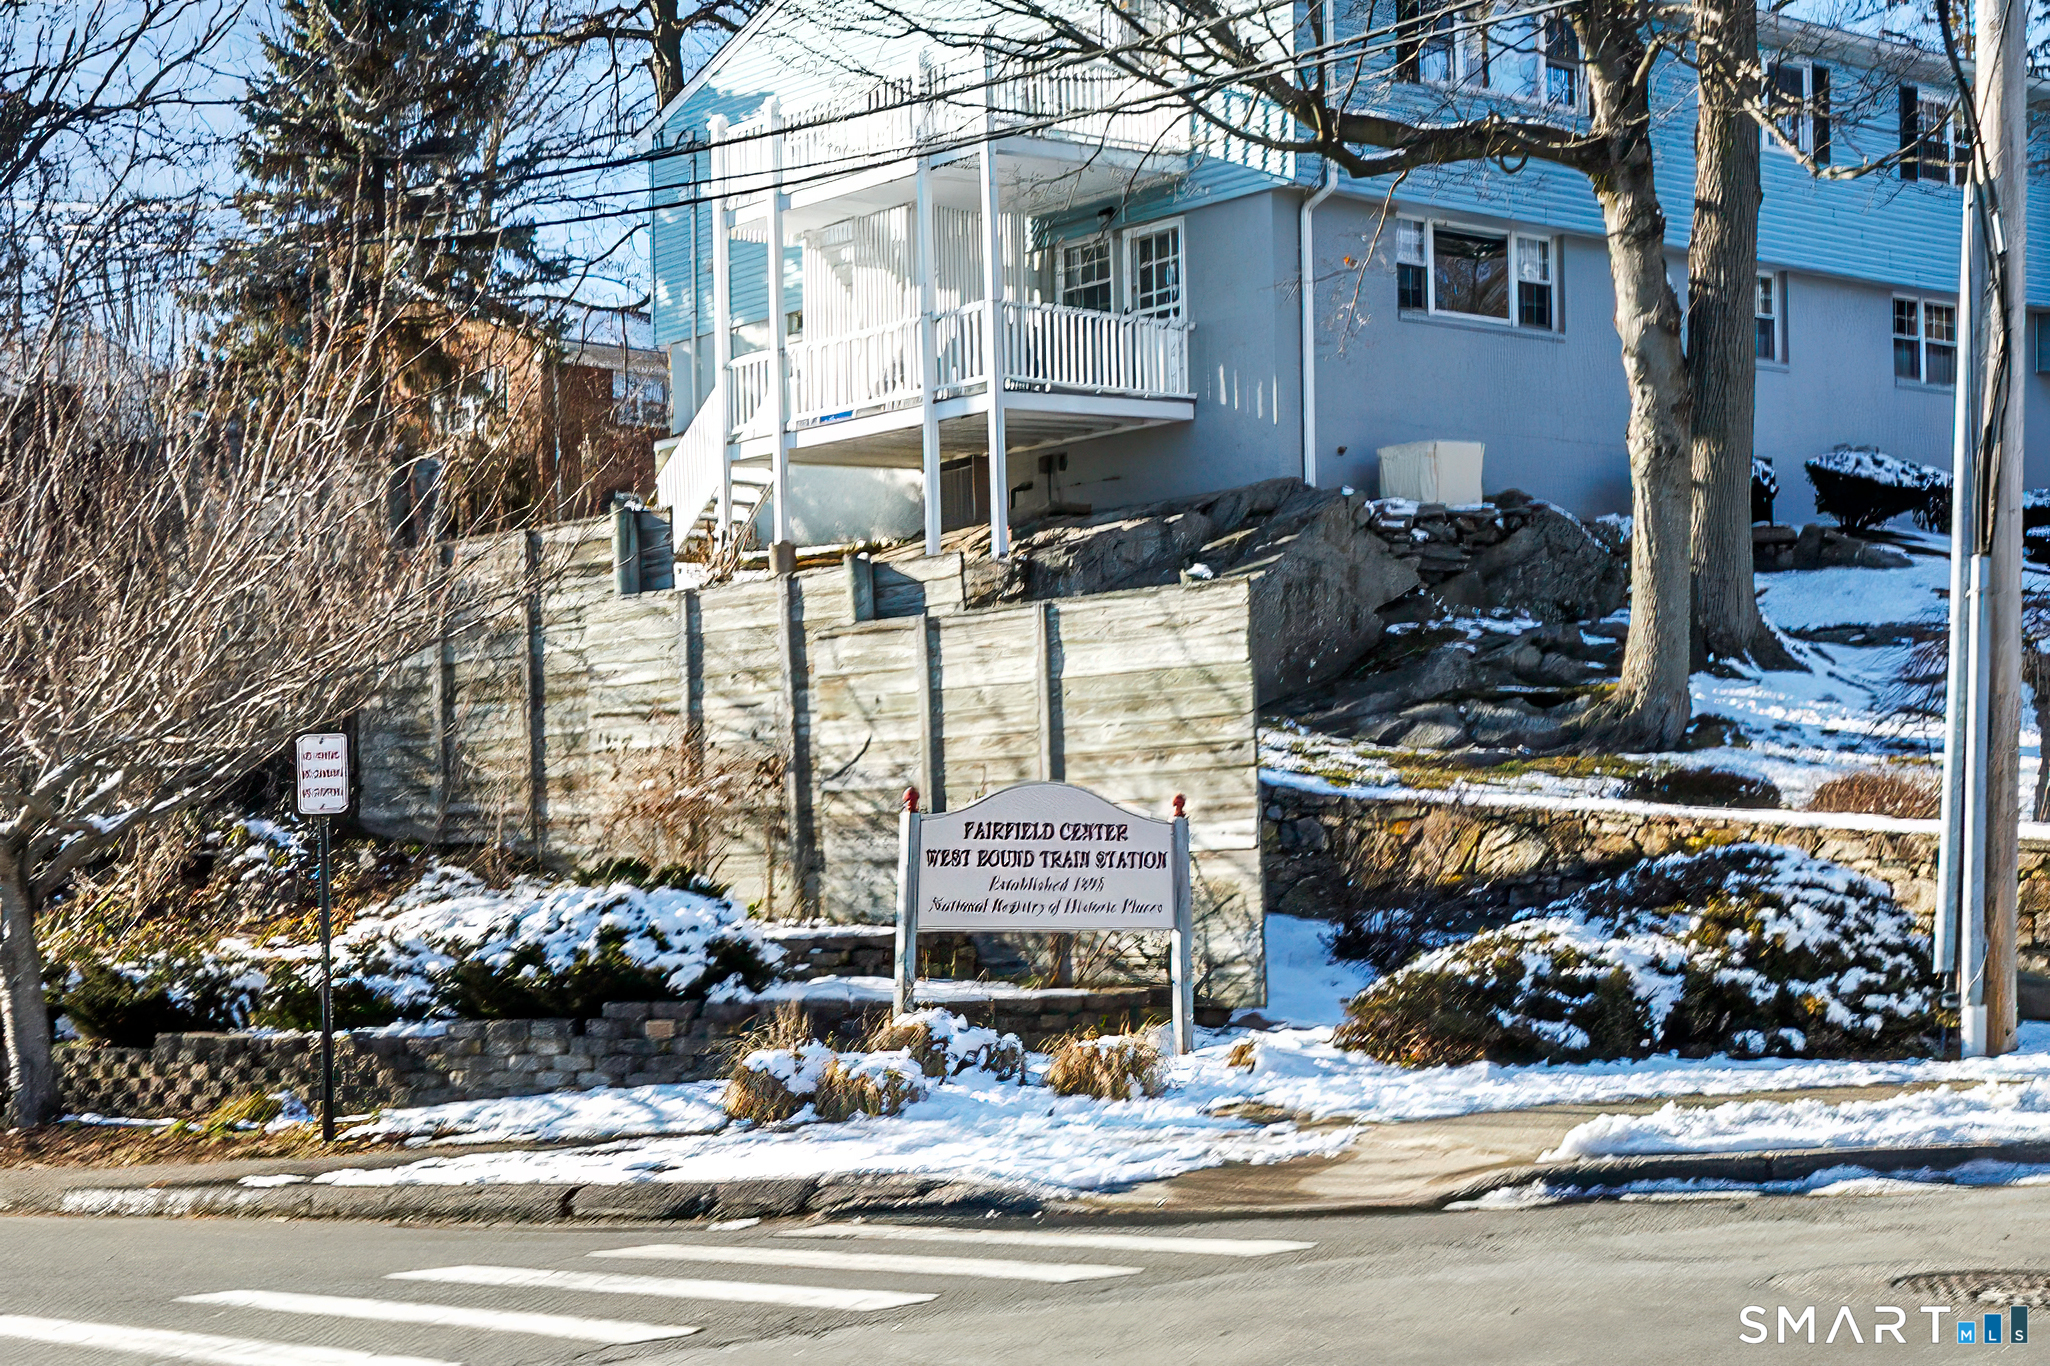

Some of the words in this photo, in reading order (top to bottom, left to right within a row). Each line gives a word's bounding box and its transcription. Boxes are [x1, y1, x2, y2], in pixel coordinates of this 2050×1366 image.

[963, 821, 1055, 841] FAIRFIELD
[1059, 823, 1129, 842] CENTER
[926, 849, 971, 868] WEST
[976, 849, 1035, 869] BOUND
[1039, 850, 1090, 869] TRAIN
[1095, 851, 1168, 870] STATION
[928, 896, 990, 913] National
